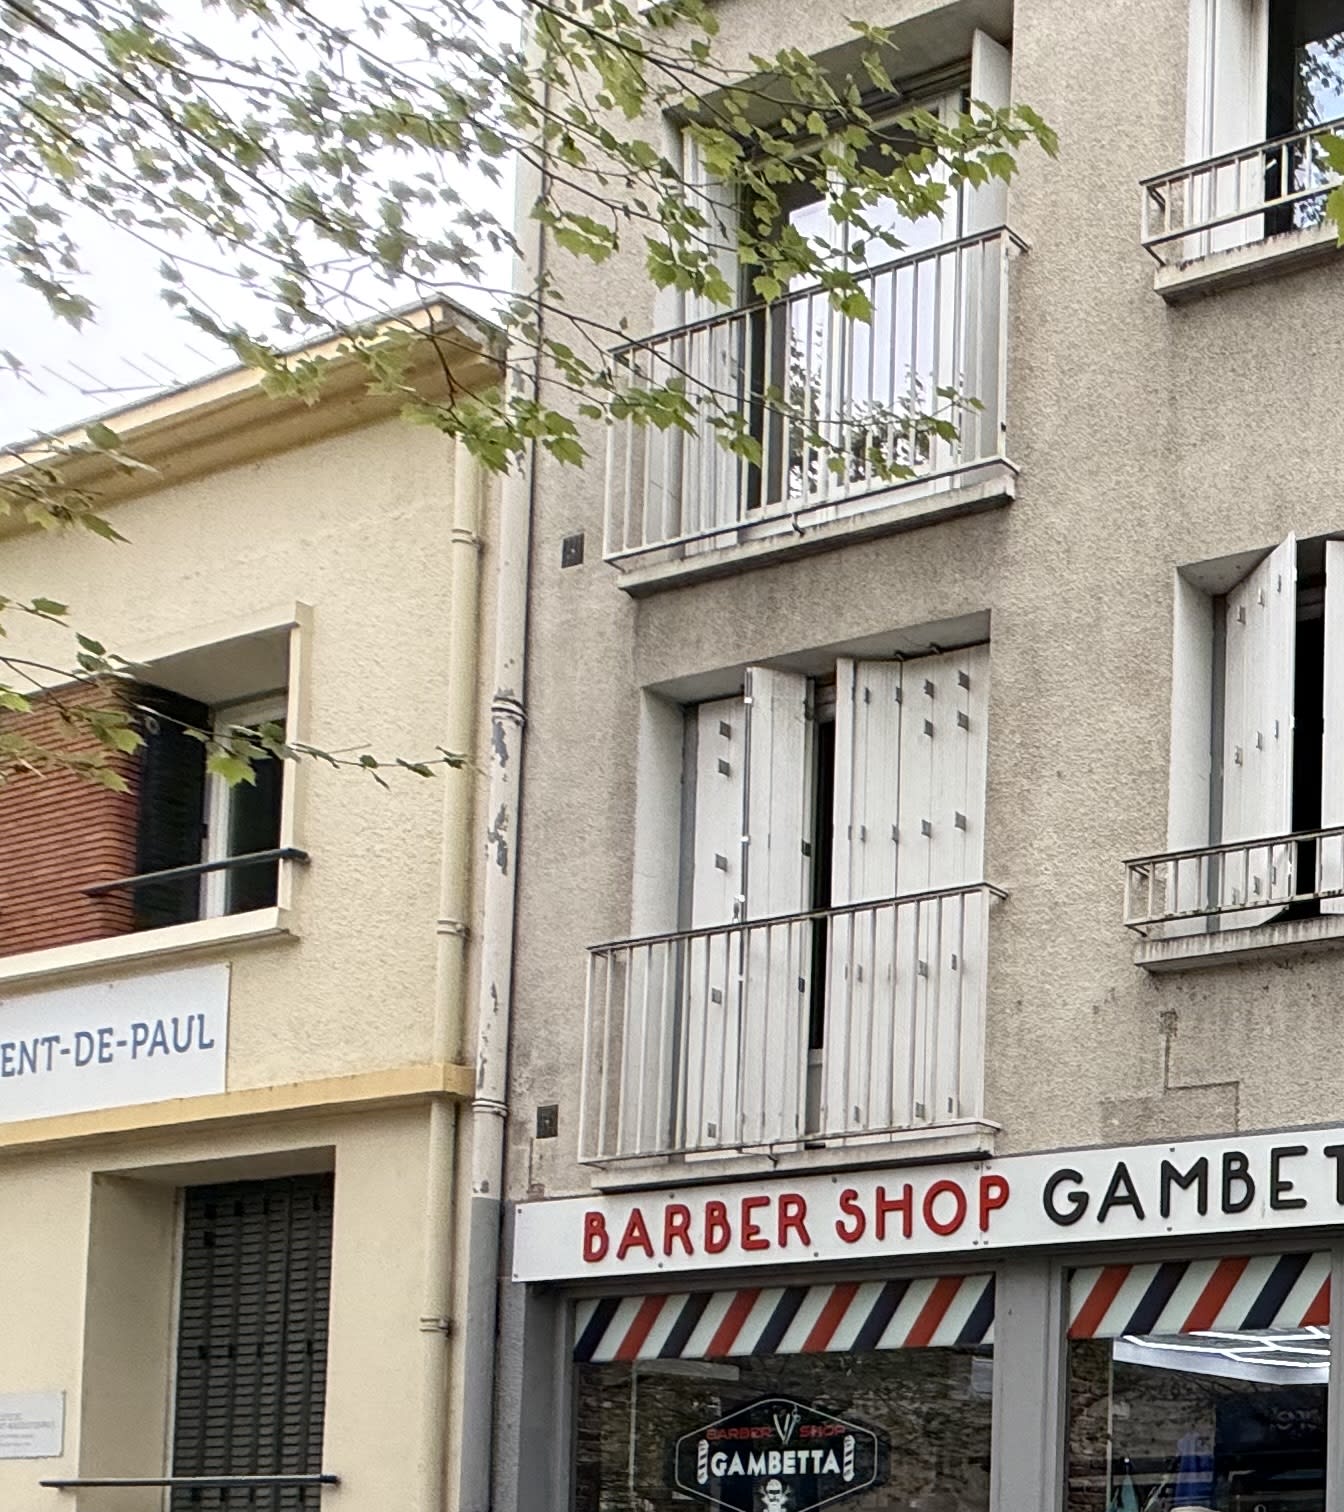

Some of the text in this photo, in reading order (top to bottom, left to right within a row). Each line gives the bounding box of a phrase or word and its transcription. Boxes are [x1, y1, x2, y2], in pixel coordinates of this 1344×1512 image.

[1, 1014, 214, 1077] ENT-DE-PAUL
[583, 1193, 811, 1263] BARBER
[835, 1174, 1010, 1243] SHOP
[706, 1424, 846, 1440] BARBER SHOP
[710, 1449, 841, 1477] GAMBETTA
